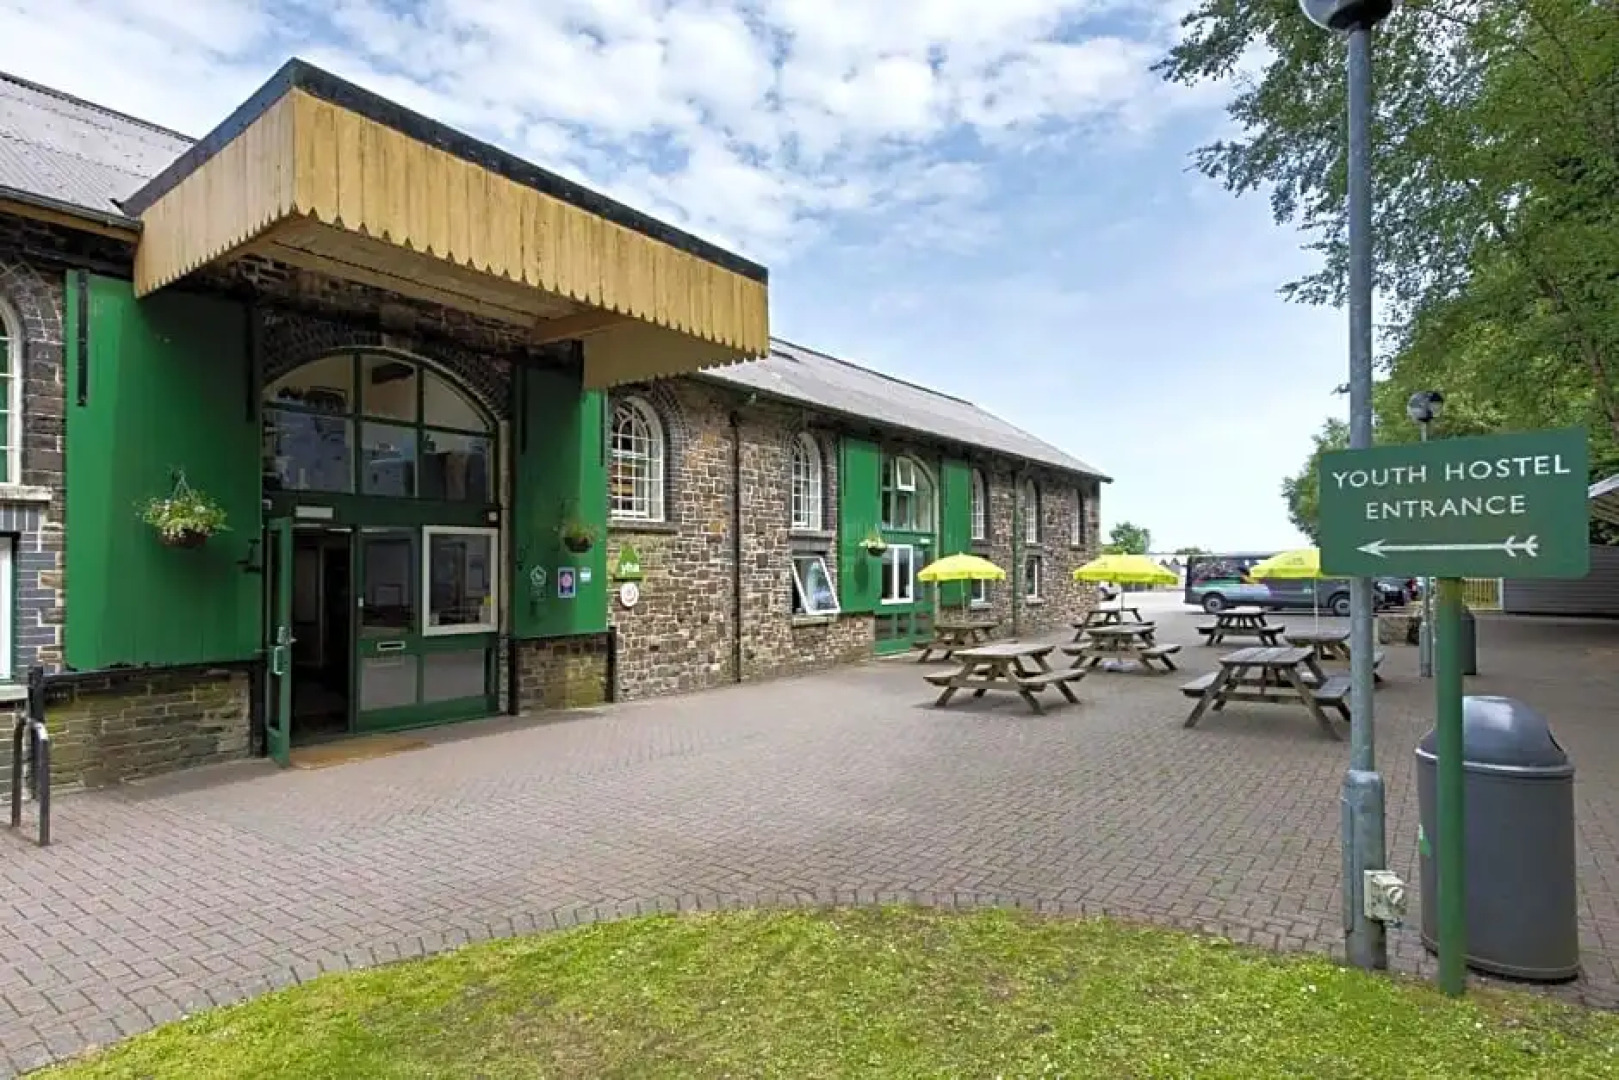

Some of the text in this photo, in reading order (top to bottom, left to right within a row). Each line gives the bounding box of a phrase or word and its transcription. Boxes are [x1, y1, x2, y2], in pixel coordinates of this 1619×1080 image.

[1332, 454, 1571, 489] YOUTH HOSTEL
[1366, 495, 1527, 520] ENTRANCE
